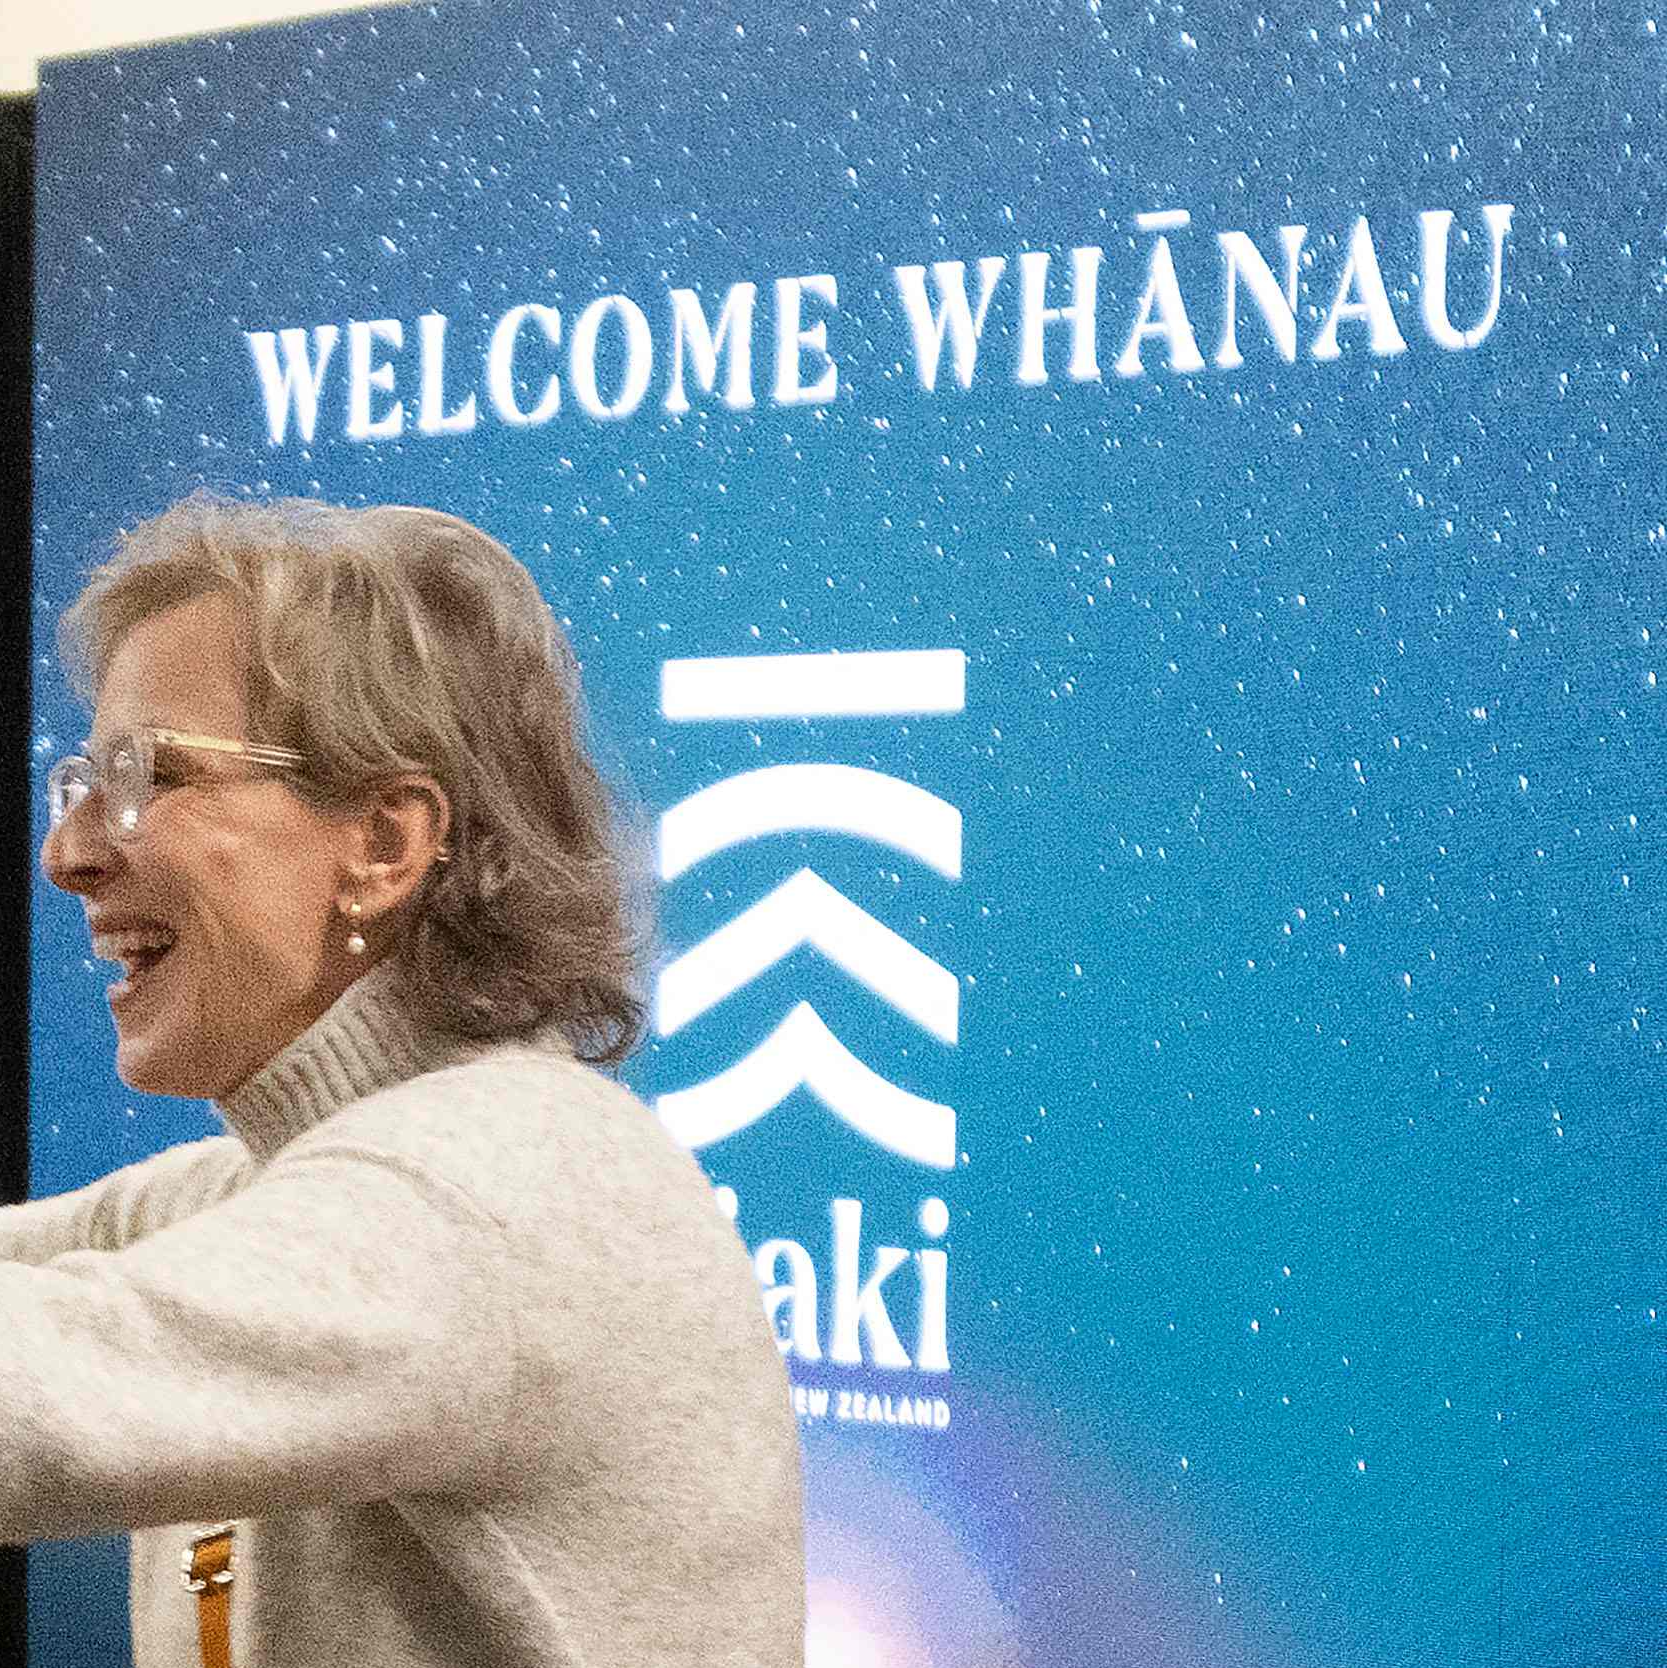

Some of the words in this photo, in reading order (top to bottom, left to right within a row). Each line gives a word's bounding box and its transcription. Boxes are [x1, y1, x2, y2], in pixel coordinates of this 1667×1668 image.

[244, 274, 838, 444] WELCOME
[895, 204, 1515, 391] WHĀNAU
[715, 1186, 952, 1372] aki
[788, 1384, 829, 1418] EW
[836, 1390, 952, 1430] ZEALAND
